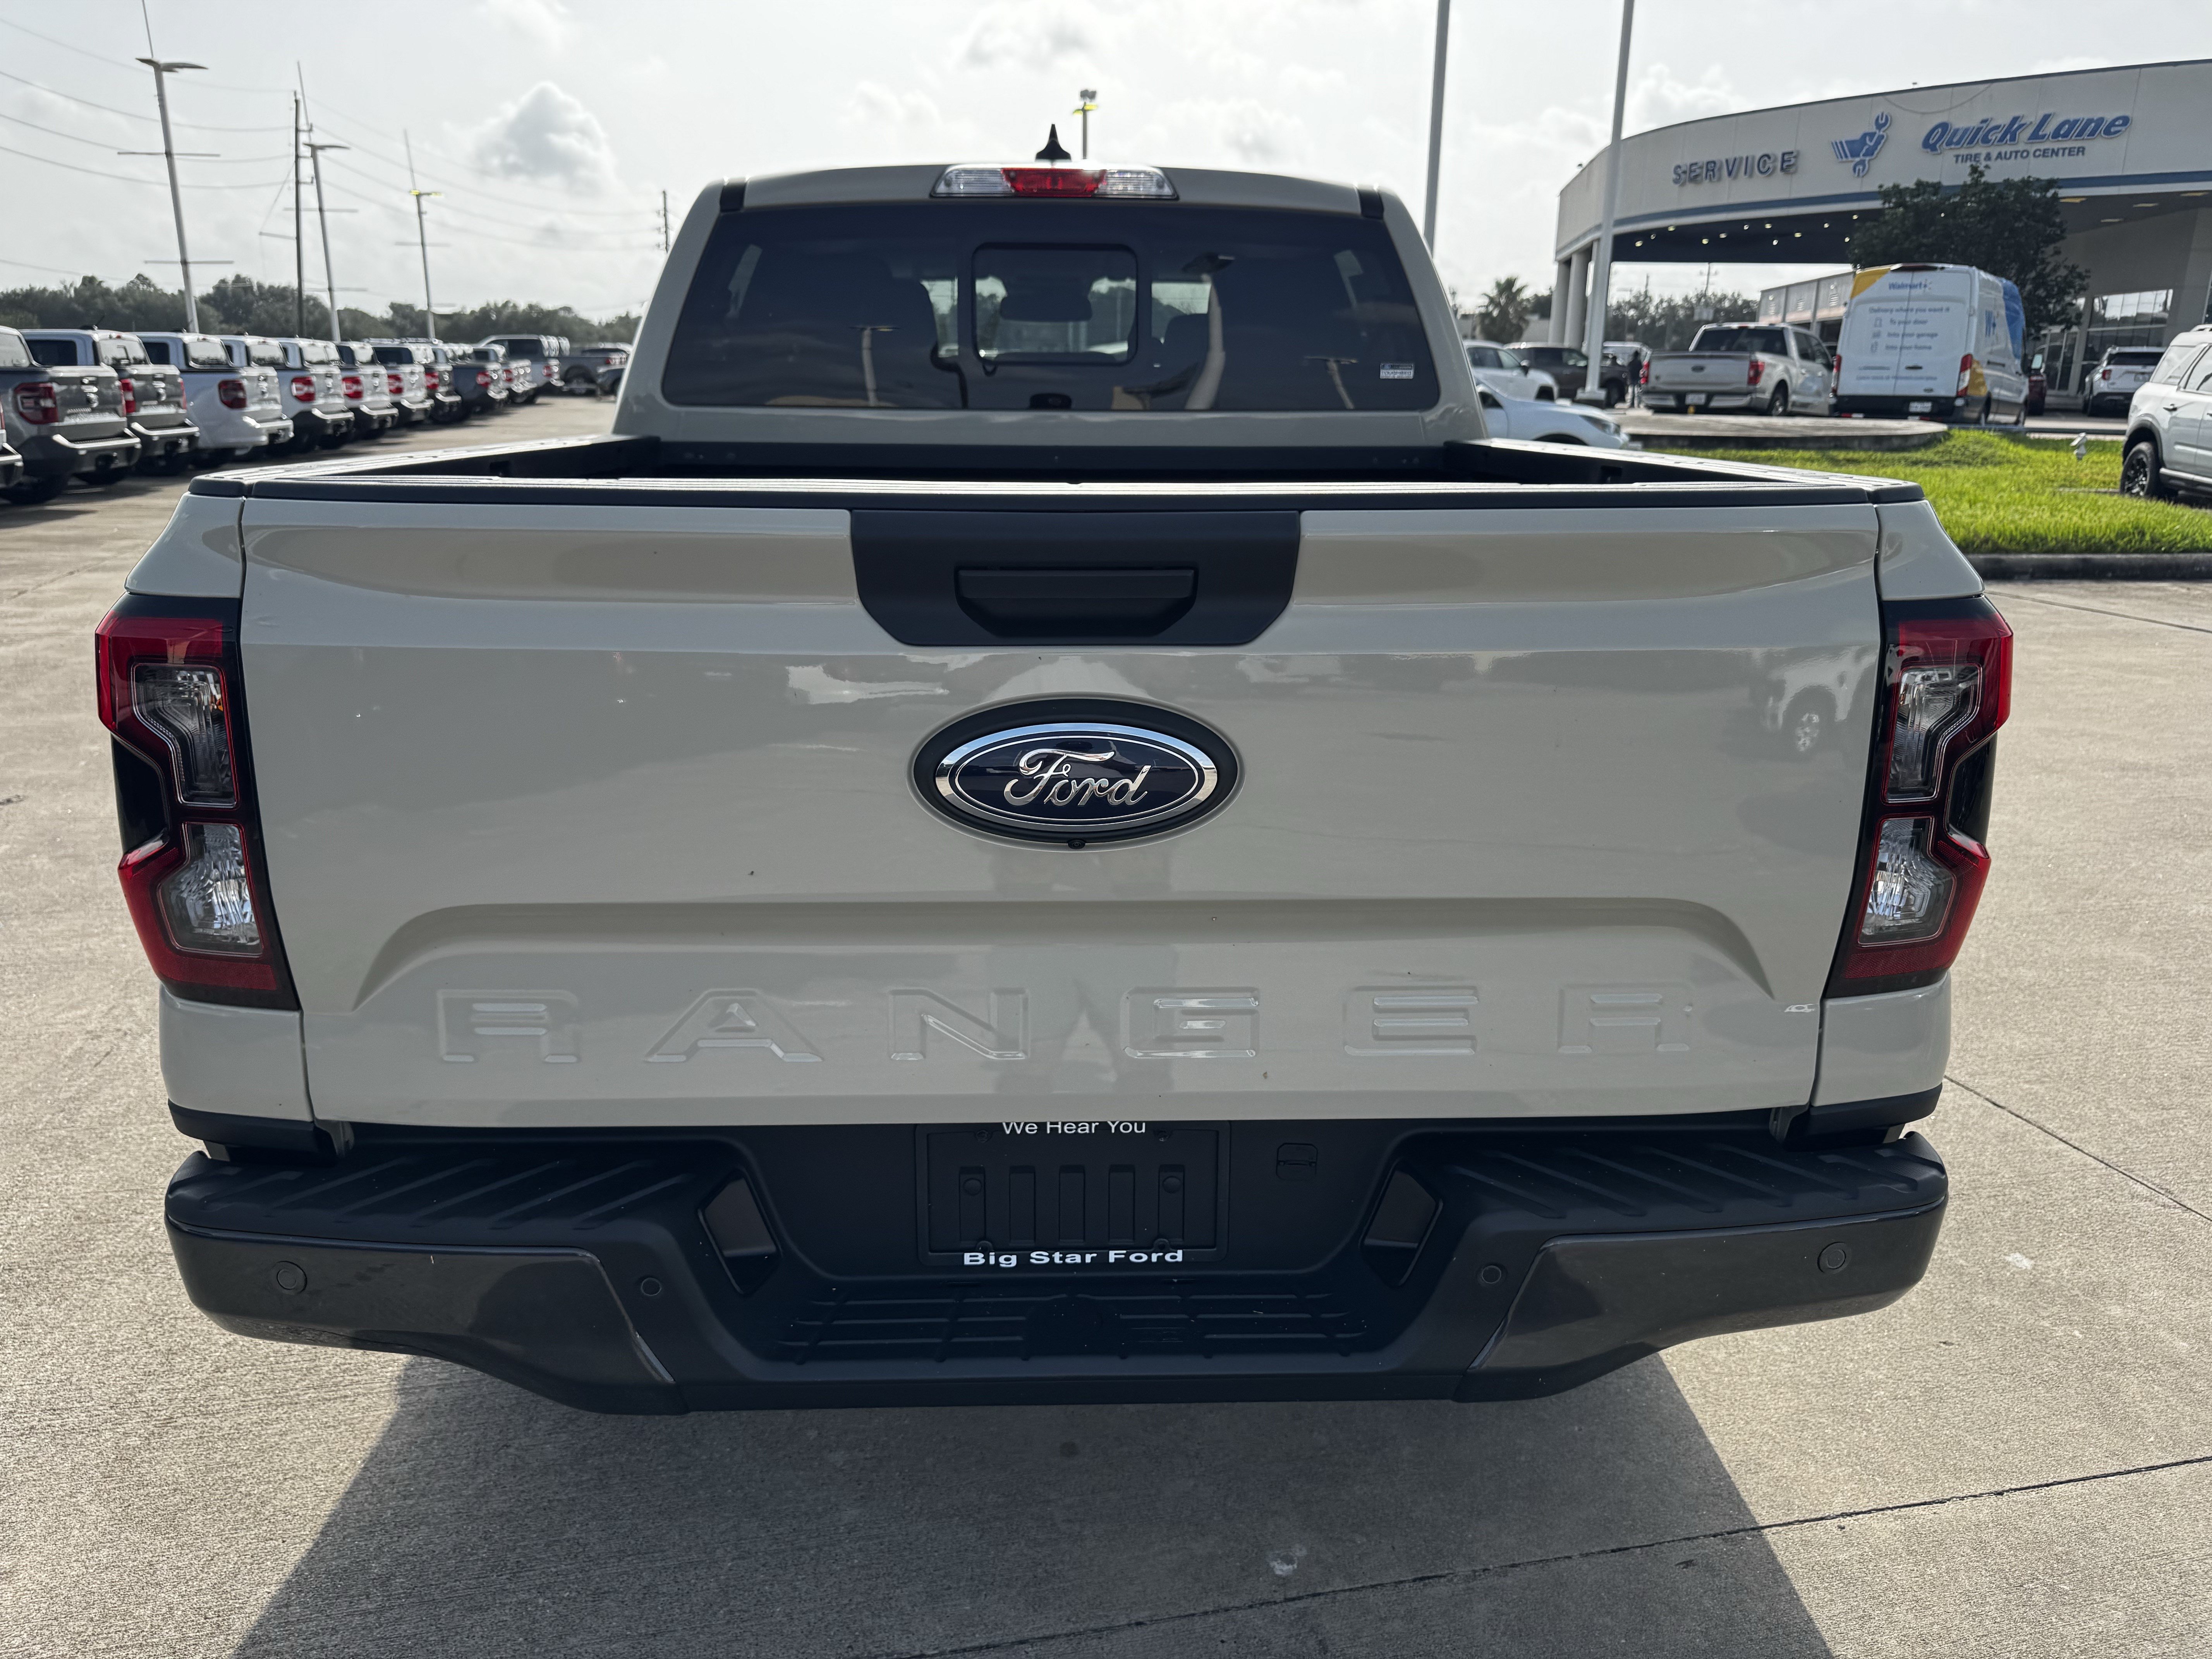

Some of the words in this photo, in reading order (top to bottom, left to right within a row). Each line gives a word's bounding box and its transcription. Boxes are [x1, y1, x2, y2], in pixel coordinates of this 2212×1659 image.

[1922, 114, 2031, 154] Quick
[2025, 112, 2132, 144] Lane
[1673, 151, 1798, 185] SERVICE
[1954, 153, 1981, 164] TIRE
[1983, 152, 1992, 162] &
[1995, 149, 2030, 161] AUTO
[2033, 146, 2085, 159] CENTER
[1004, 748, 1151, 806] Ford
[437, 985, 1692, 1063] RANGER
[1002, 1121, 1038, 1134] We
[1047, 1121, 1099, 1134] Hear
[1107, 1120, 1146, 1133] You
[963, 1252, 1017, 1267] Big
[1030, 1251, 1097, 1264] Star
[1108, 1249, 1183, 1263] Ford
